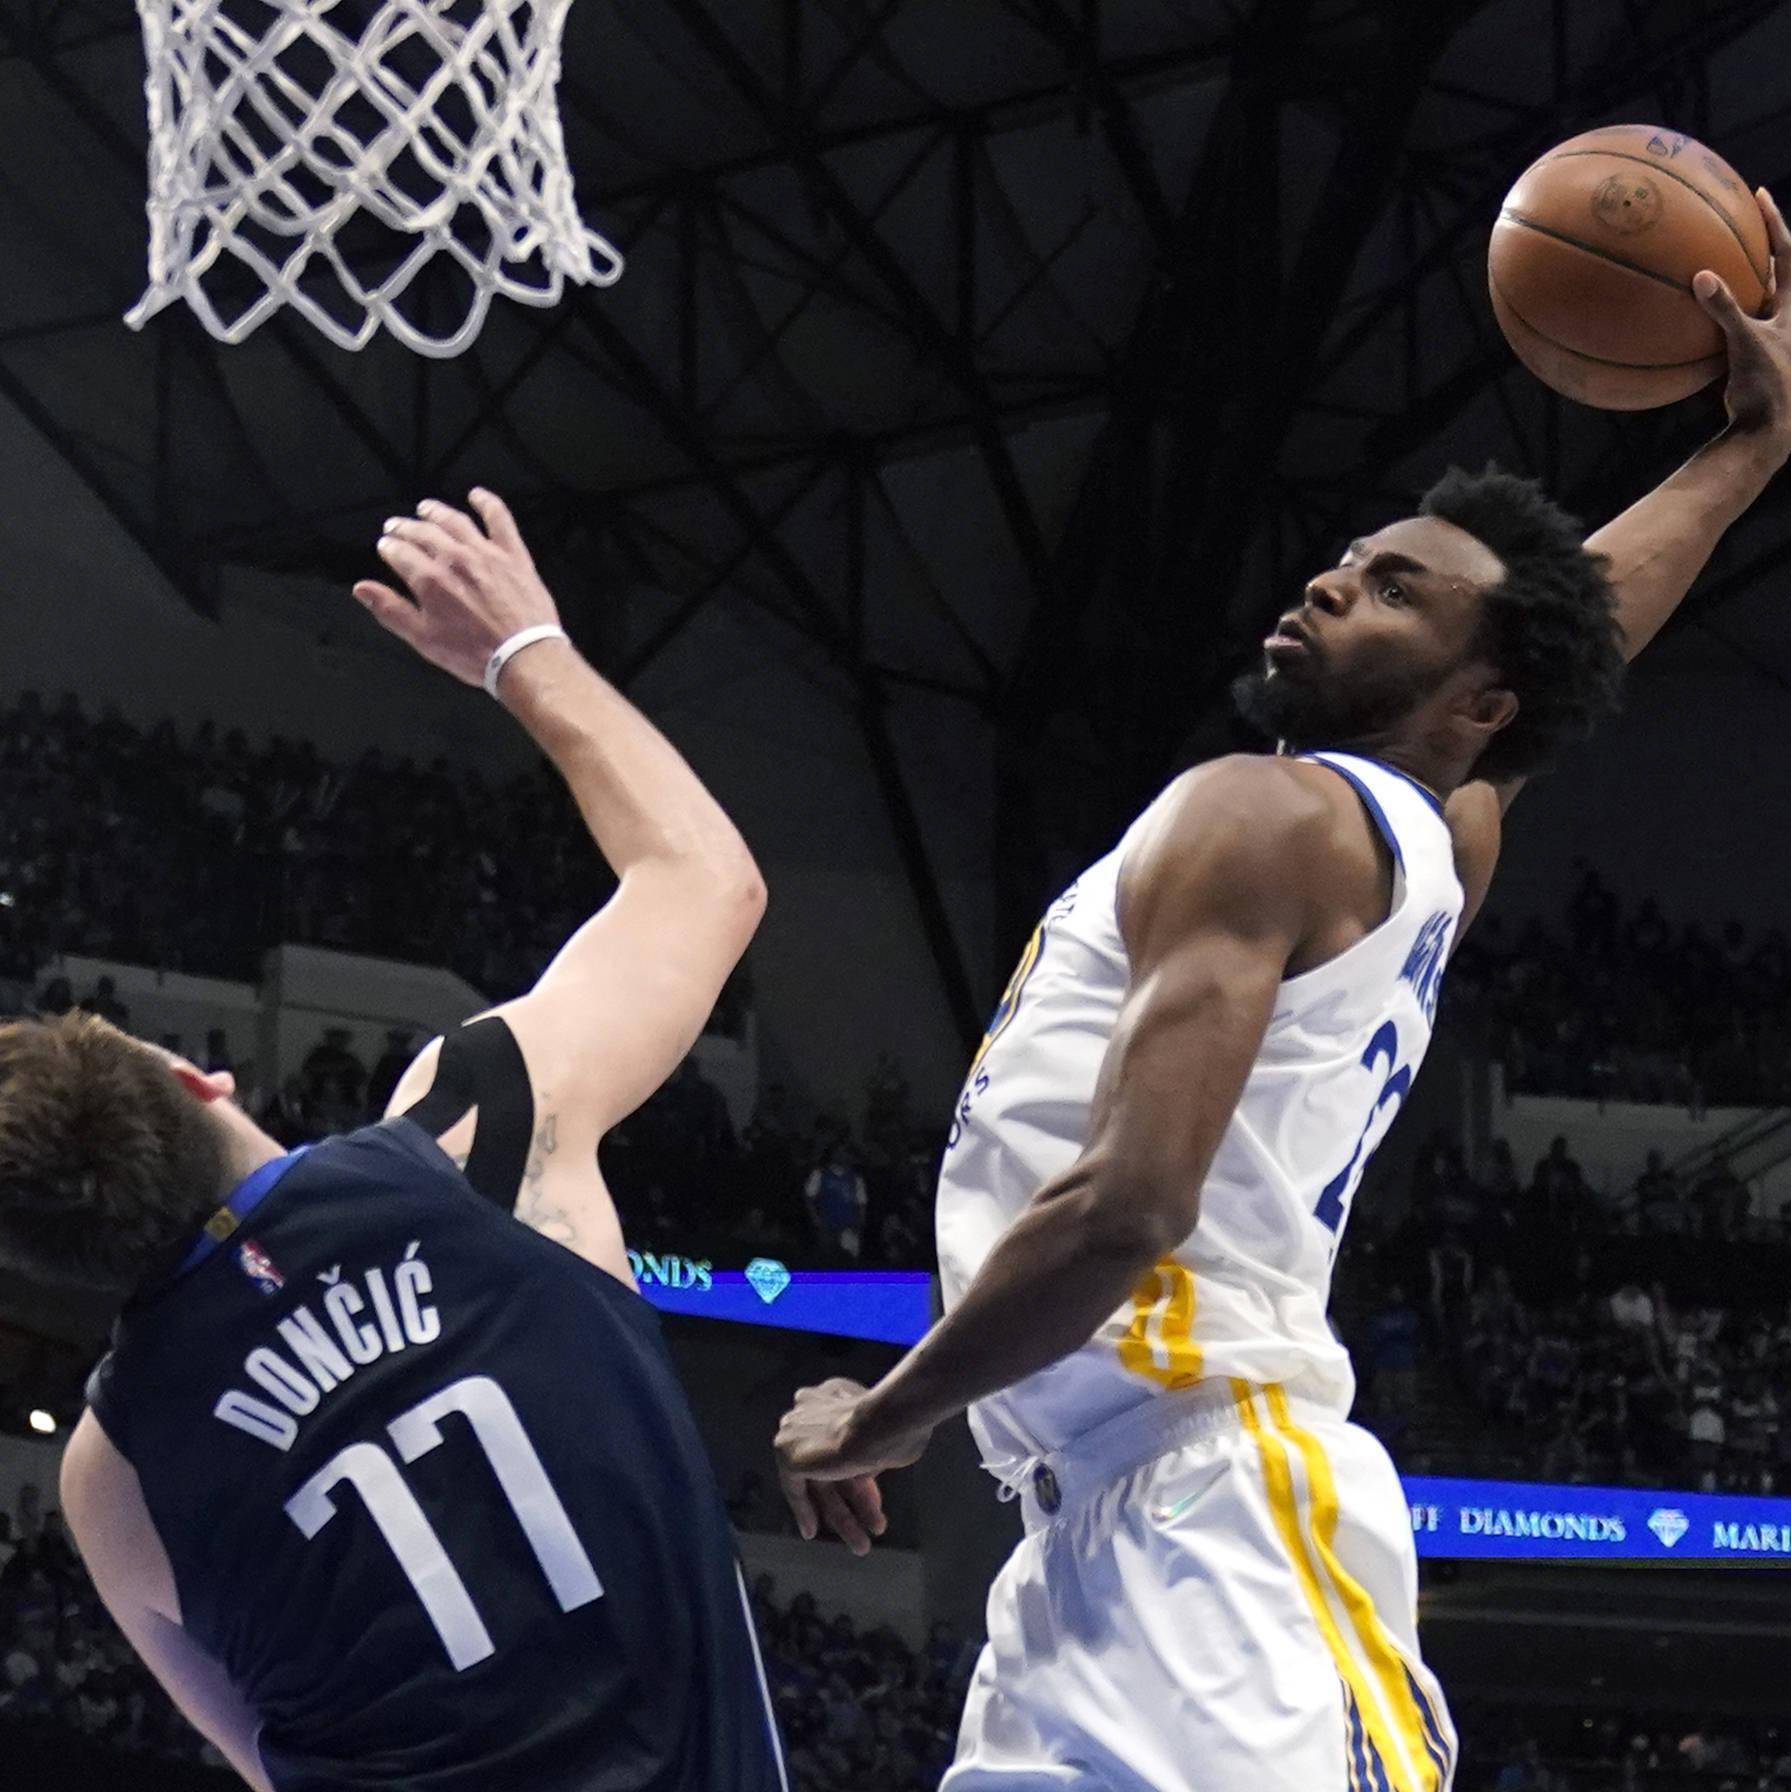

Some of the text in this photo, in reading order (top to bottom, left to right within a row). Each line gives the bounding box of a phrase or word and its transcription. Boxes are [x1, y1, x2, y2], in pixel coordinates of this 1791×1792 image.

[212, 1240, 442, 1452] DONČIĆ
[283, 1374, 605, 1672] 77
[1460, 1505, 1626, 1543] DIAMONDS
